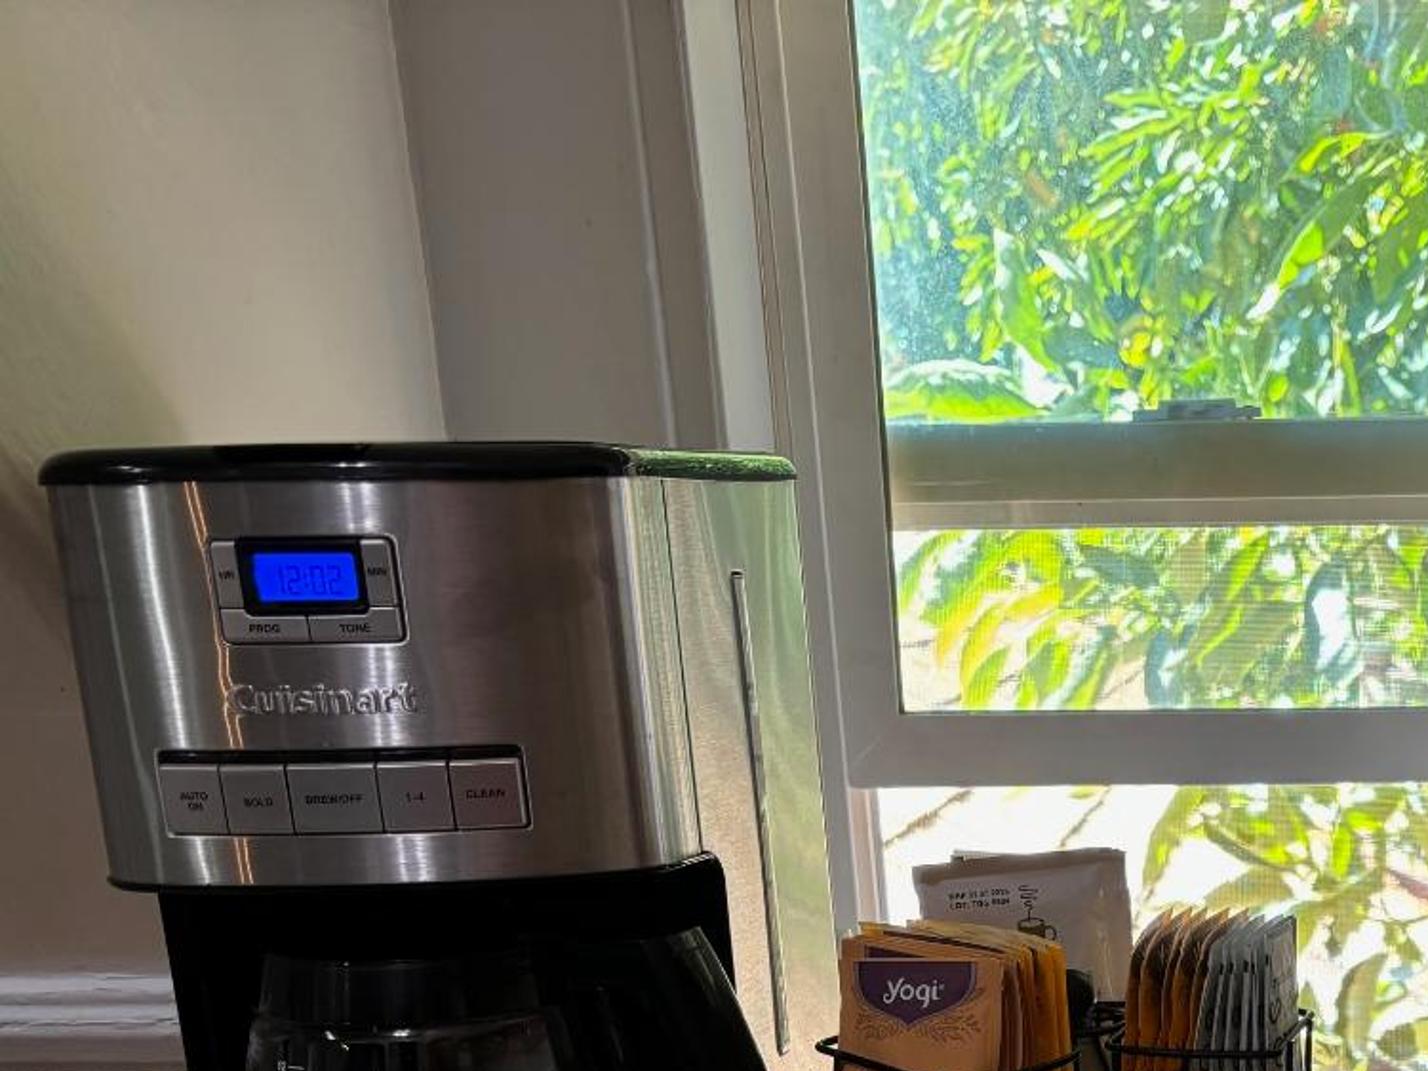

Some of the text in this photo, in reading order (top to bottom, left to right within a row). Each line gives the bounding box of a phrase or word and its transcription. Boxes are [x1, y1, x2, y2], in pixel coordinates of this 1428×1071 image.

[280, 565, 342, 595] 12:02
[226, 681, 419, 716] Cuisinart
[465, 788, 506, 801] CLEAN
